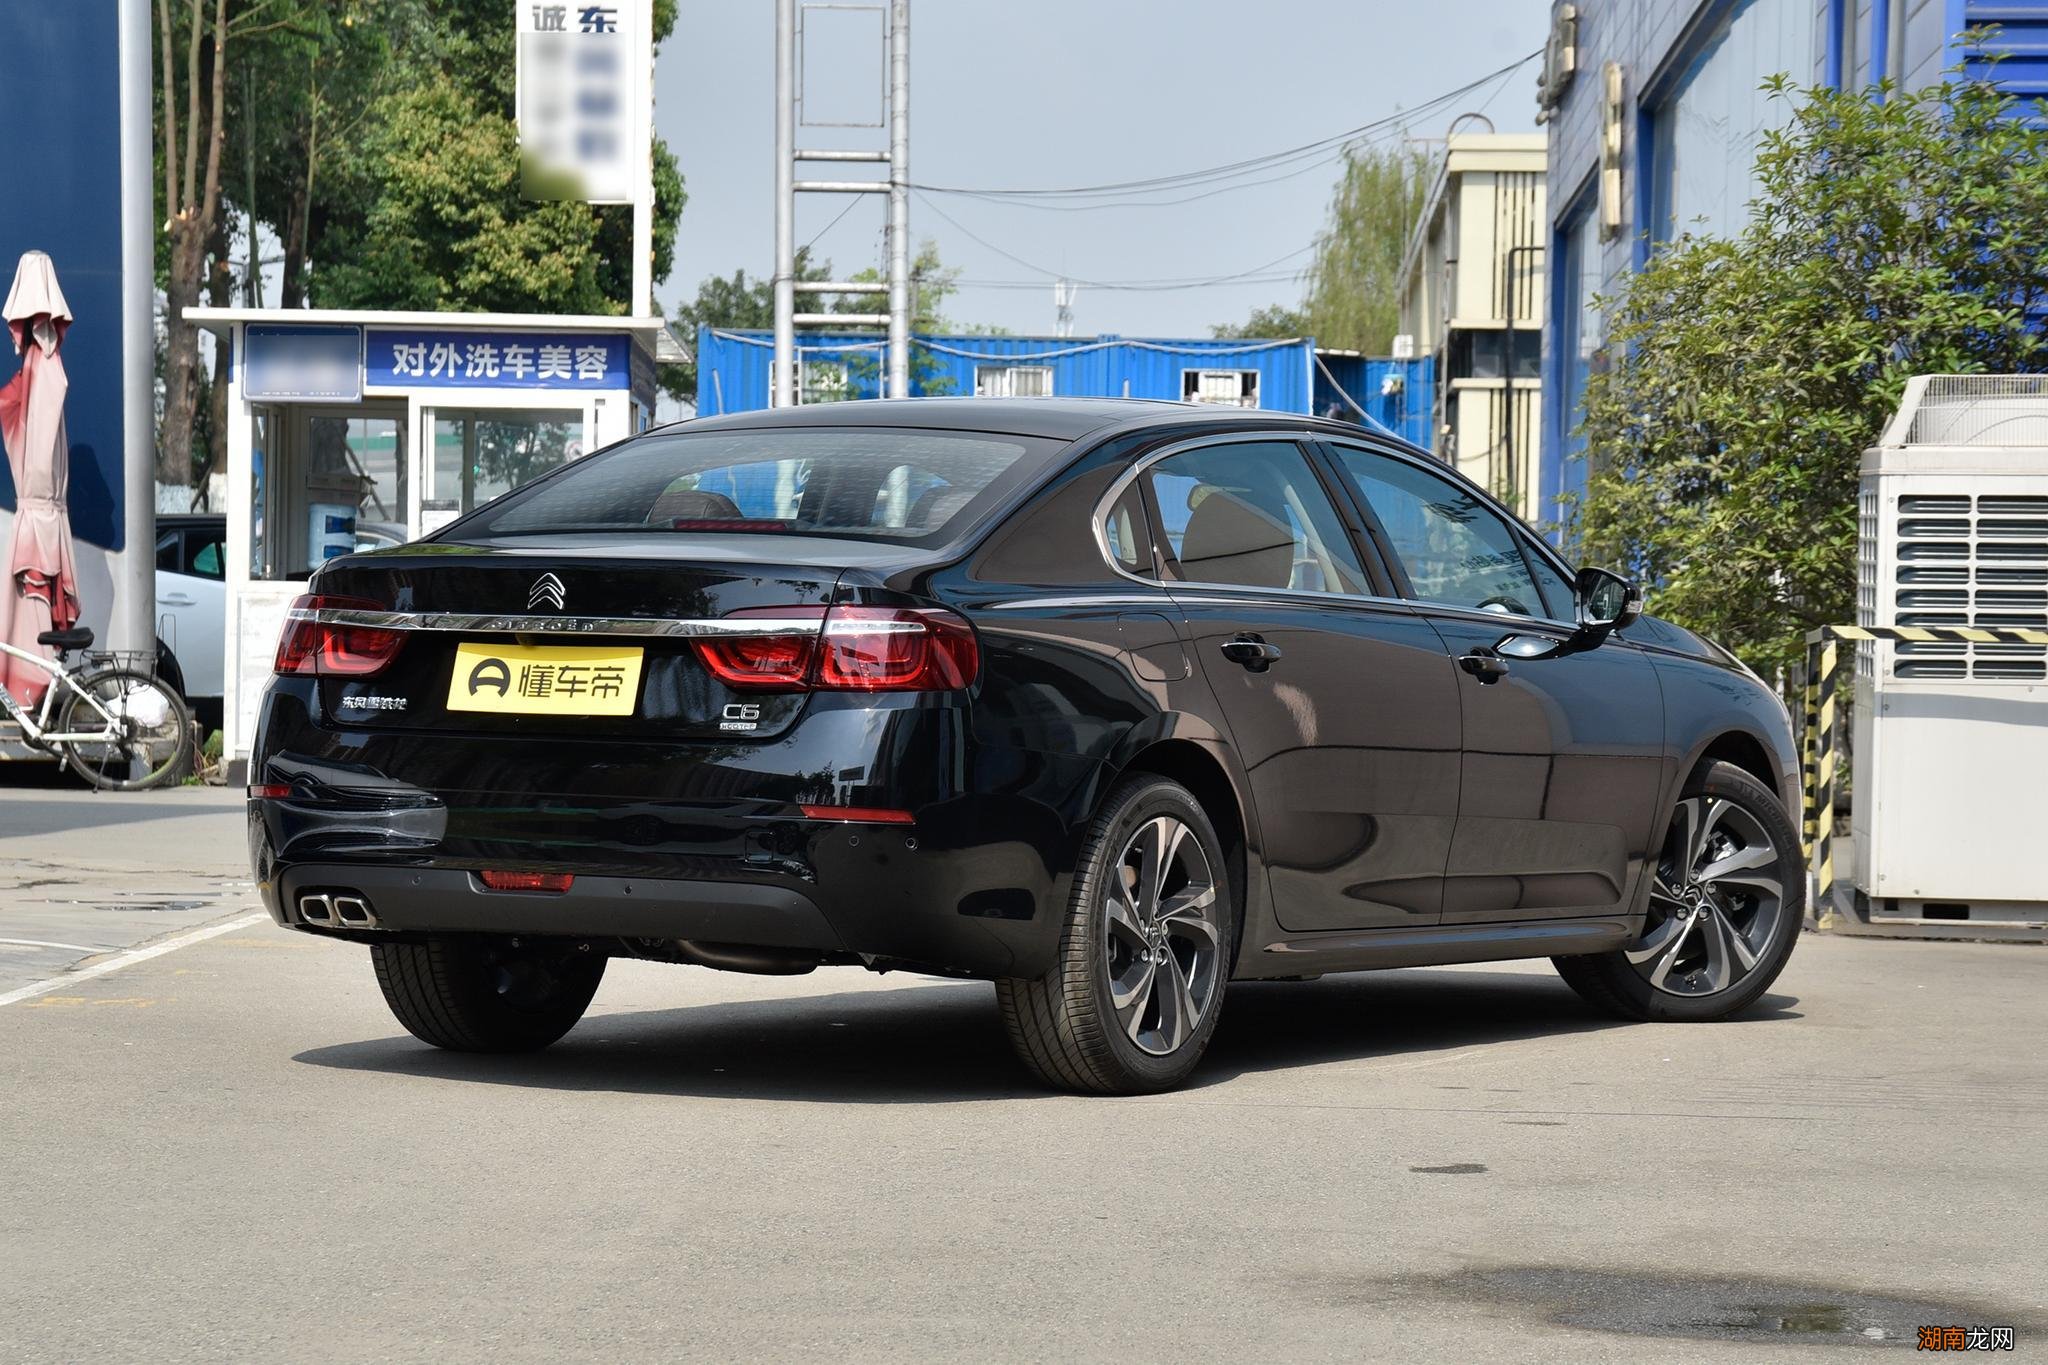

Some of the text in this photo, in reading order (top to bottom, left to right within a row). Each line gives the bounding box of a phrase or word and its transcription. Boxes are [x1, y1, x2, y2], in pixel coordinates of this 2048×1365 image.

[392, 342, 608, 380] 对外洗车美容
[518, 664, 625, 698] 懂车帝
[723, 703, 760, 720] C6
